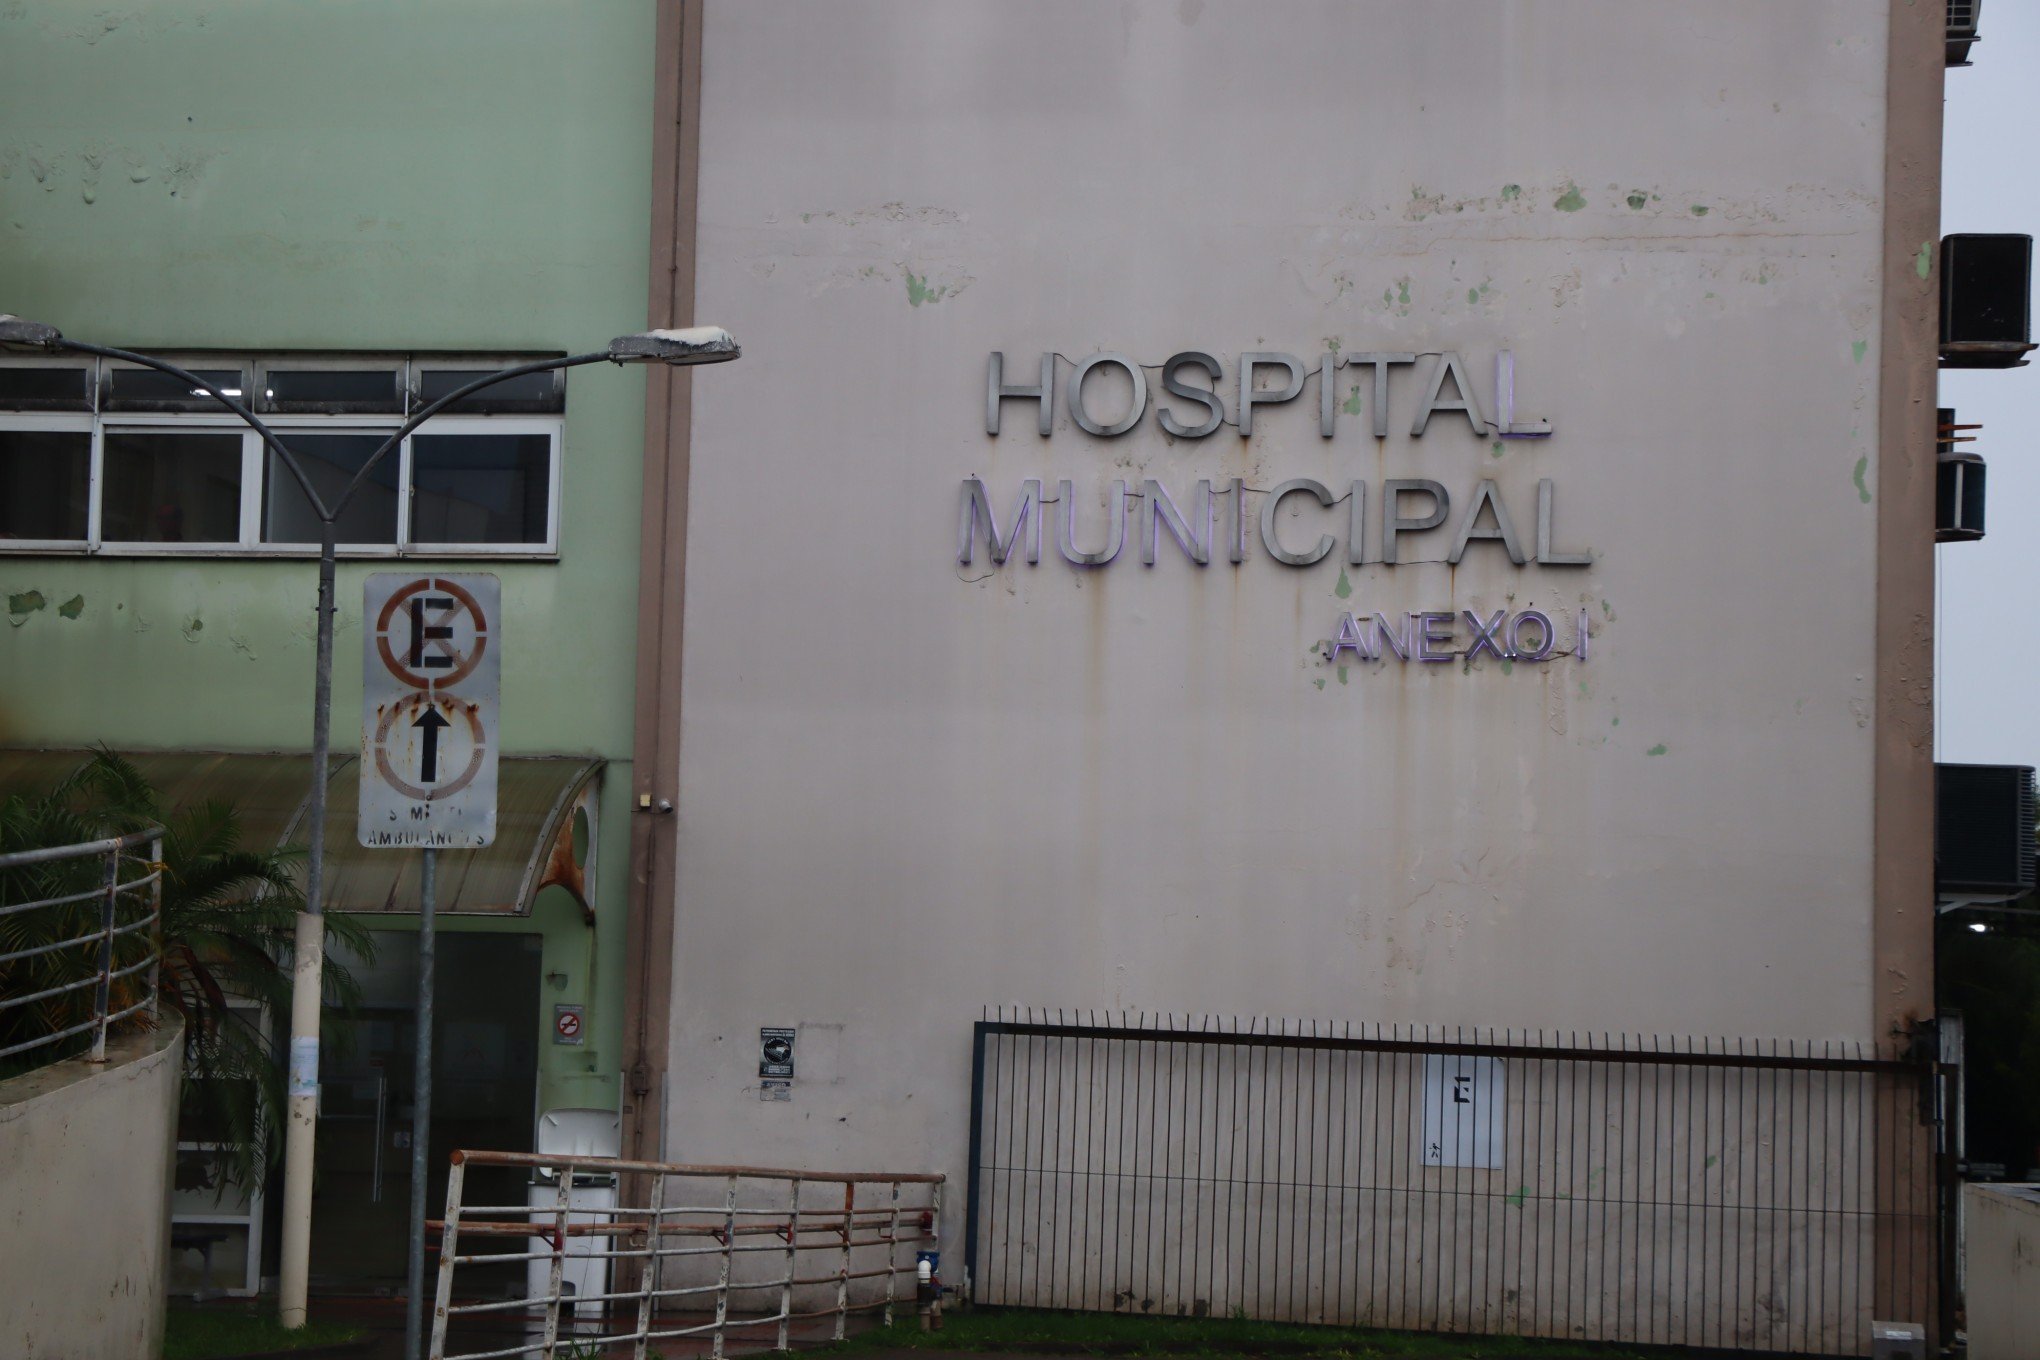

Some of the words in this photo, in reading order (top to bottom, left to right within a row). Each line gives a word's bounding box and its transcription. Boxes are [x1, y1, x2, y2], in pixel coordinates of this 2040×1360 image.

[986, 351, 1553, 438] HOSPITAL
[958, 478, 1592, 567] MUNICIPAL
[410, 598, 454, 668] E
[1325, 610, 1555, 661] ANEXO
[1576, 608, 1588, 660] I
